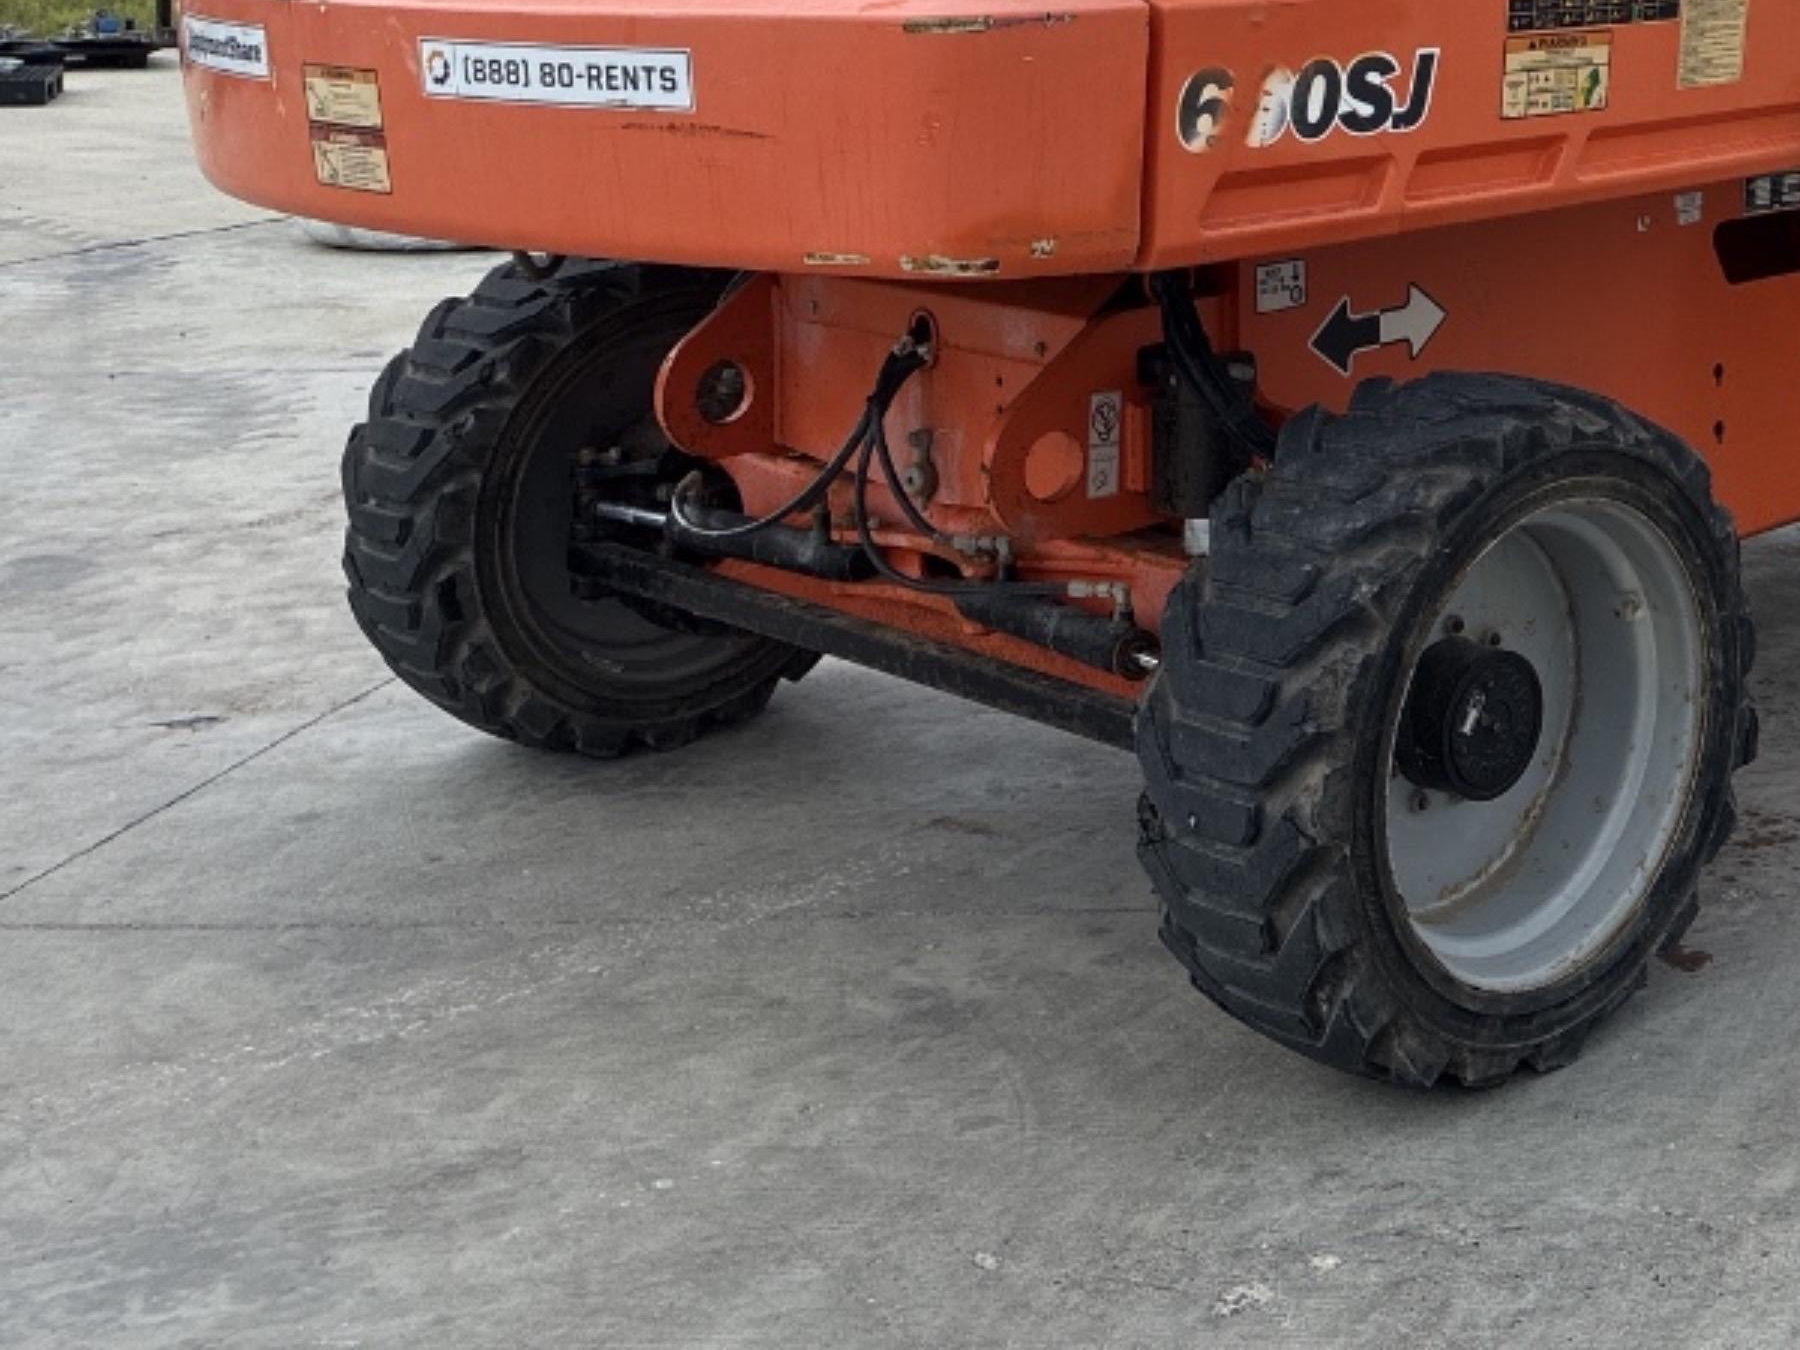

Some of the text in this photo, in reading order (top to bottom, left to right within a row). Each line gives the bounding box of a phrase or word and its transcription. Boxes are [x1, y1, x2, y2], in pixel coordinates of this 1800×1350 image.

[464, 53, 678, 93] (888) 80-RENTS
[1176, 48, 1440, 154] 60SJ
